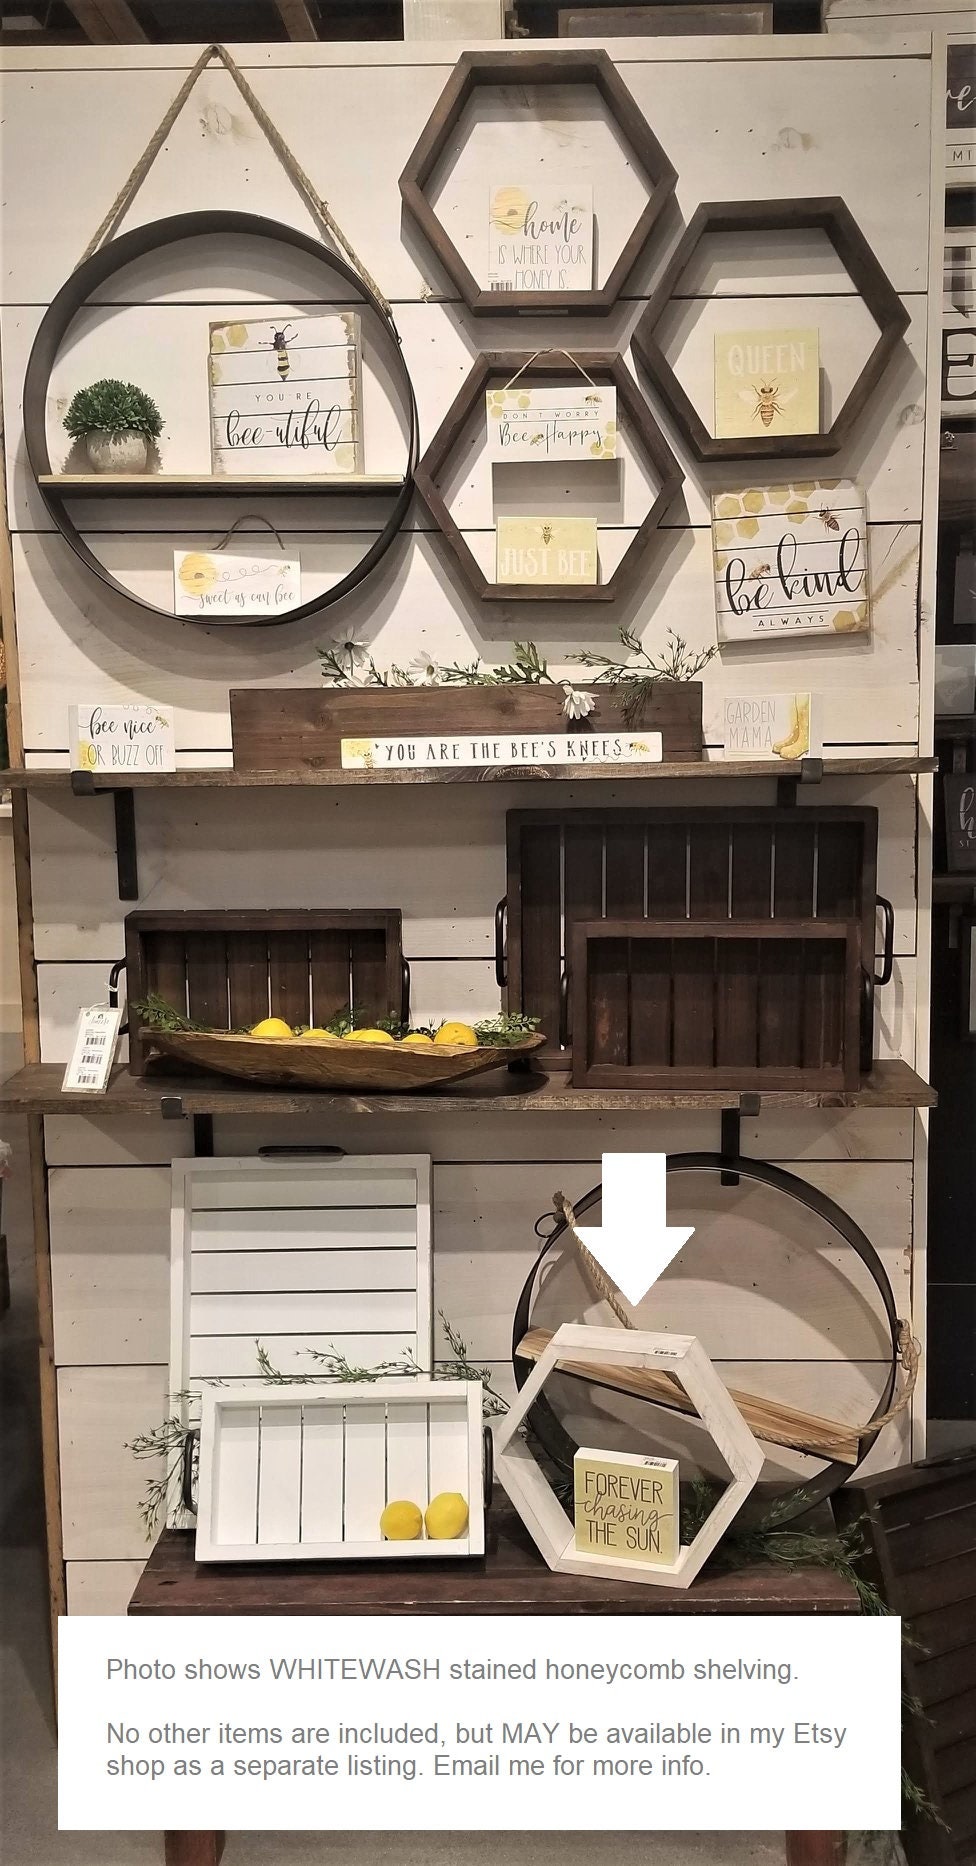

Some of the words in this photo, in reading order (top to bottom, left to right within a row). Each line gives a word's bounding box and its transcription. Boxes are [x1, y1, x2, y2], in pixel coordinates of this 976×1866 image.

[524, 200, 582, 242] home
[498, 244, 507, 264] IS
[513, 244, 549, 264] WHERE
[555, 244, 587, 264] YOUR
[514, 269, 552, 289] HONEY
[558, 269, 569, 289] IS.
[728, 342, 806, 378] QUEEN
[255, 392, 312, 402] YOU'RE
[226, 398, 343, 452] bee-utiful
[499, 422, 528, 446] Bee
[541, 420, 602, 453] Happy
[501, 547, 552, 577] JUST
[558, 549, 591, 577] BEE
[725, 557, 775, 616] be
[776, 527, 865, 600] kind
[200, 588, 230, 609] sweet
[234, 592, 246, 608] as
[250, 592, 269, 605] can
[274, 583, 295, 605] bee
[758, 615, 824, 627] ALWAYS
[89, 706, 118, 740] bee
[124, 719, 156, 741] nice
[726, 700, 776, 724] GARDEN
[385, 743, 416, 761] YOU
[426, 743, 460, 760] ARE
[470, 742, 501, 759] THE
[511, 740, 556, 759] BEE'S
[567, 739, 622, 757] KNEES
[729, 726, 772, 748] MAMA
[87, 743, 106, 766] OR
[111, 744, 140, 766] BUZZ
[145, 744, 164, 766] OFF
[585, 1470, 663, 1505] FOREVER
[576, 1490, 674, 1533] chasing
[585, 1519, 617, 1547] THE
[626, 1525, 663, 1555] SUN.
